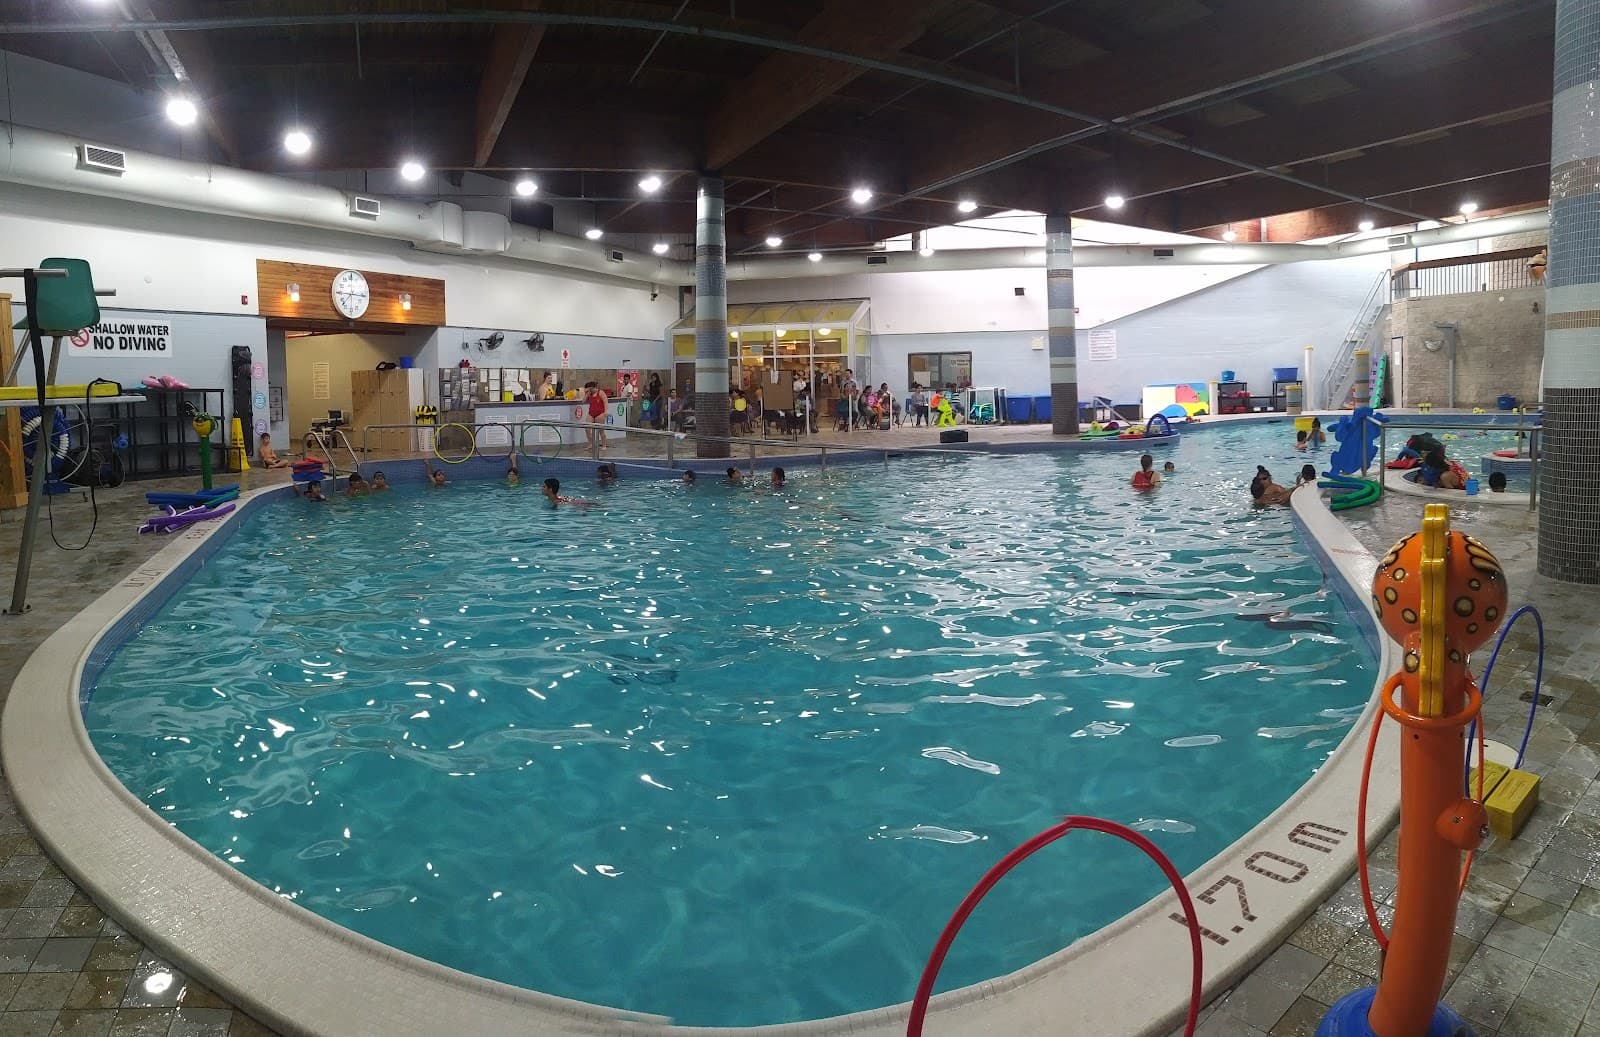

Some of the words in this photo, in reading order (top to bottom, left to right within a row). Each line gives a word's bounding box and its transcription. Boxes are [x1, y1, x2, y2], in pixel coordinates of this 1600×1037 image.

[89, 323, 135, 335] SHALLOW
[137, 325, 169, 336] WATER
[93, 336, 115, 350] NO
[119, 337, 166, 351] DIVING
